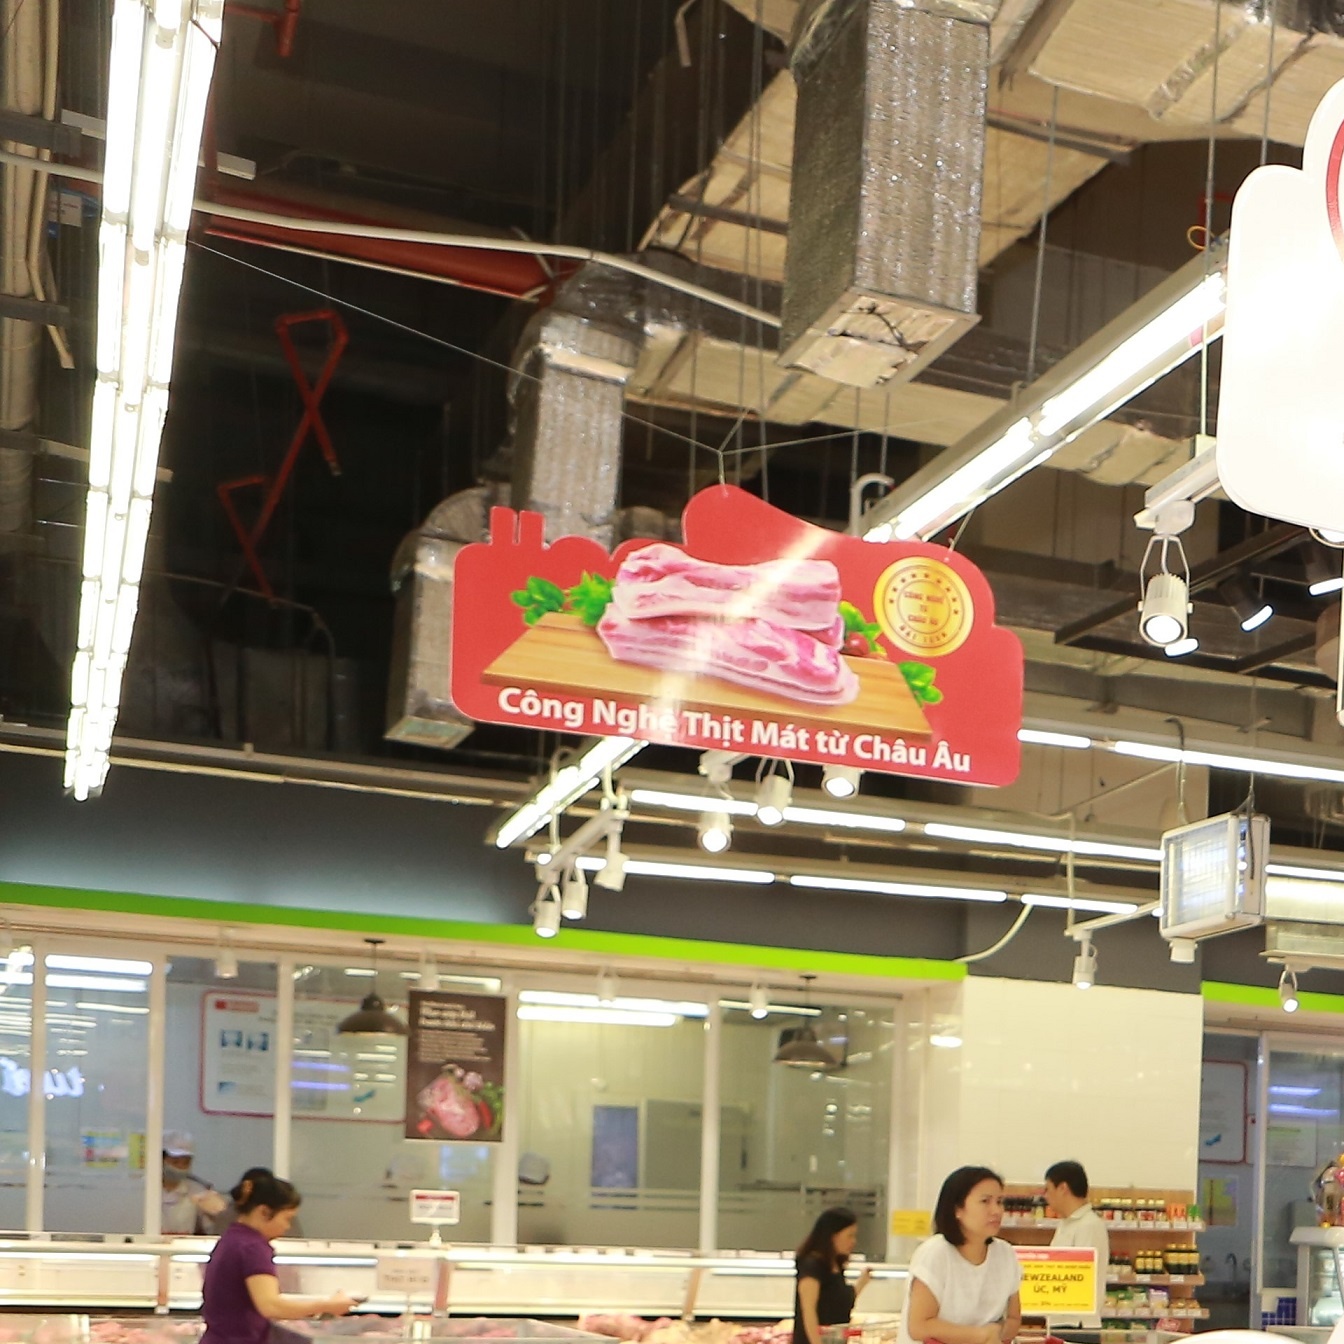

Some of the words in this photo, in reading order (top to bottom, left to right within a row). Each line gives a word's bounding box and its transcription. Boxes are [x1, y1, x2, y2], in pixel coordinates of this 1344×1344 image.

[498, 686, 585, 727] Công
[593, 698, 678, 737] Nghệ
[683, 710, 744, 747] Thịt
[751, 717, 809, 751] Mát
[816, 730, 850, 756] từ
[853, 733, 927, 767] Châu
[933, 739, 971, 773] Âu
